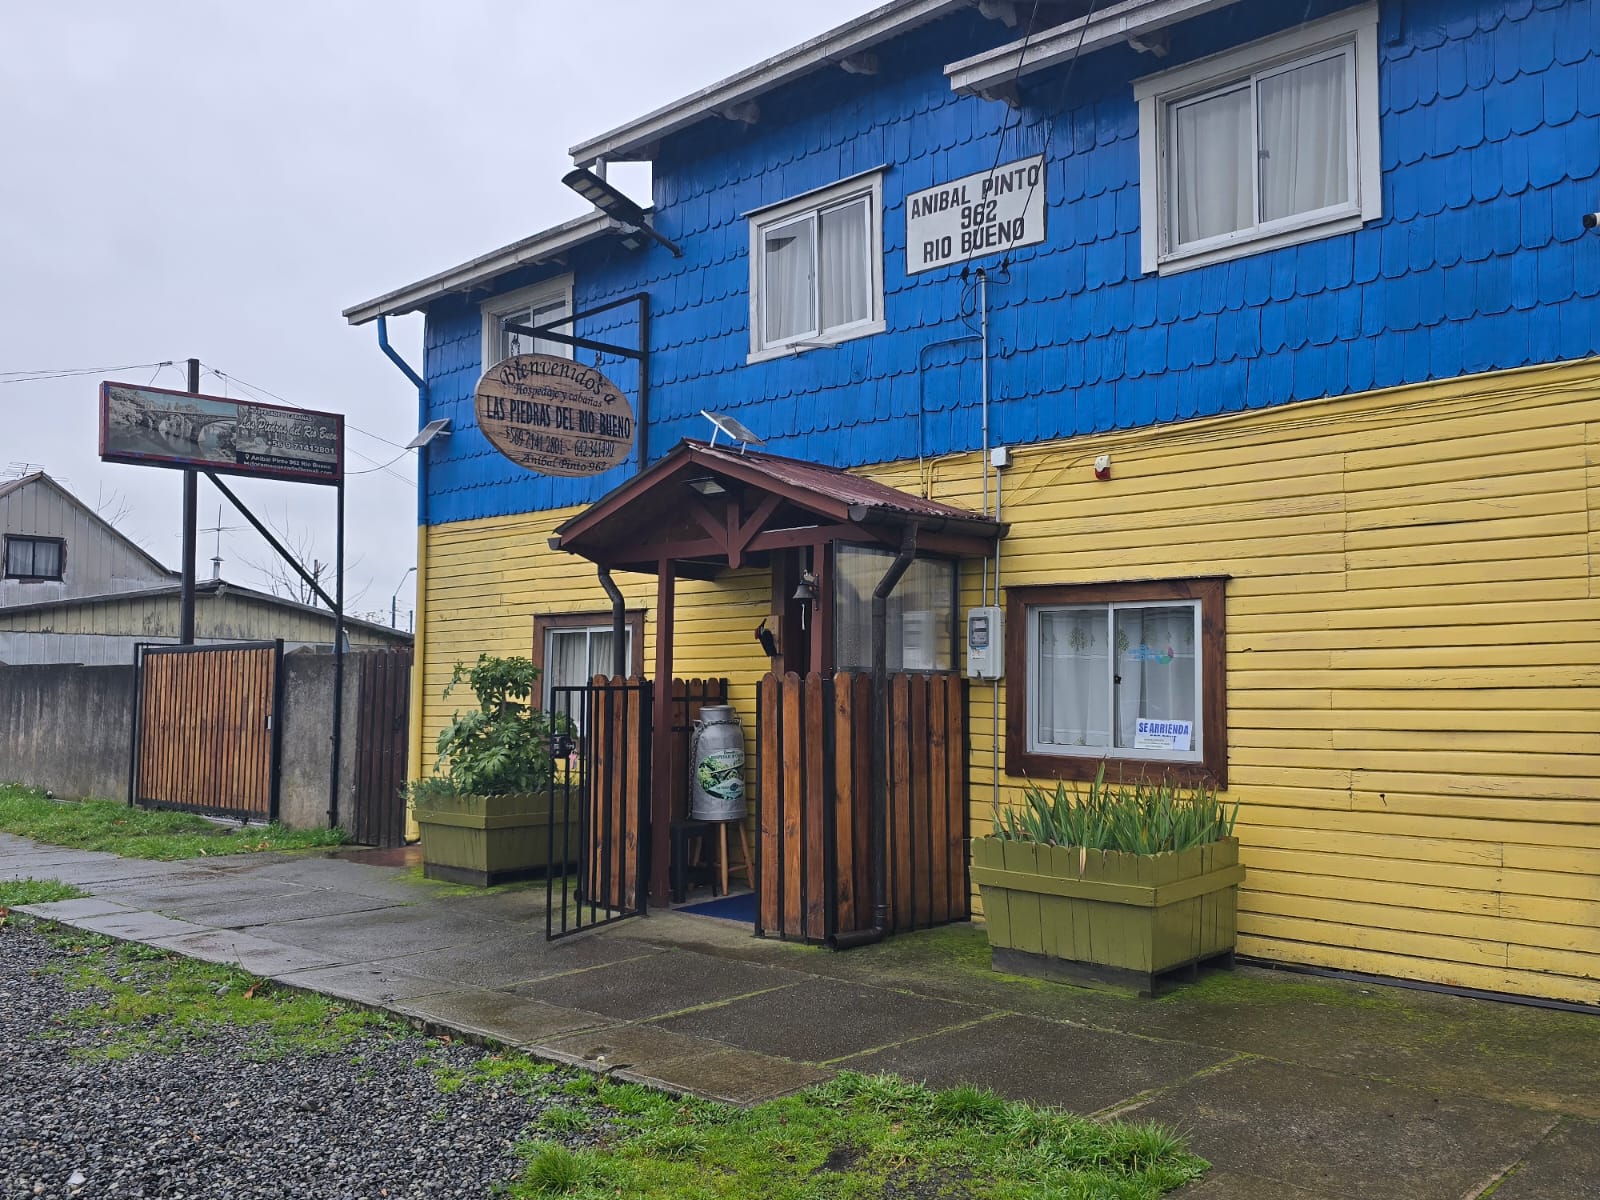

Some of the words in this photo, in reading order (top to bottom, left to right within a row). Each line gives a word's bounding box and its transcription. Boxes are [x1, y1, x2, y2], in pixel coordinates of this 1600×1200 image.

[911, 185, 971, 219] ANIBAL
[981, 164, 1040, 199] PINTO
[960, 200, 998, 230] 962
[923, 235, 952, 263] RIO
[961, 217, 1025, 254] BUENO
[500, 358, 606, 395] Bienvenidos
[513, 383, 559, 401] Hospedaje
[569, 392, 602, 408] cabañas
[239, 416, 256, 430] Las
[258, 419, 288, 434] Piedras
[289, 423, 302, 436] del
[486, 395, 505, 421] LAS
[510, 399, 551, 428] PIEDRAS
[555, 407, 575, 431] DEL
[579, 409, 595, 434] RIO
[599, 412, 631, 439] BUENO
[1139, 722, 1149, 733] SE
[1149, 723, 1189, 736] ARRIENDA
